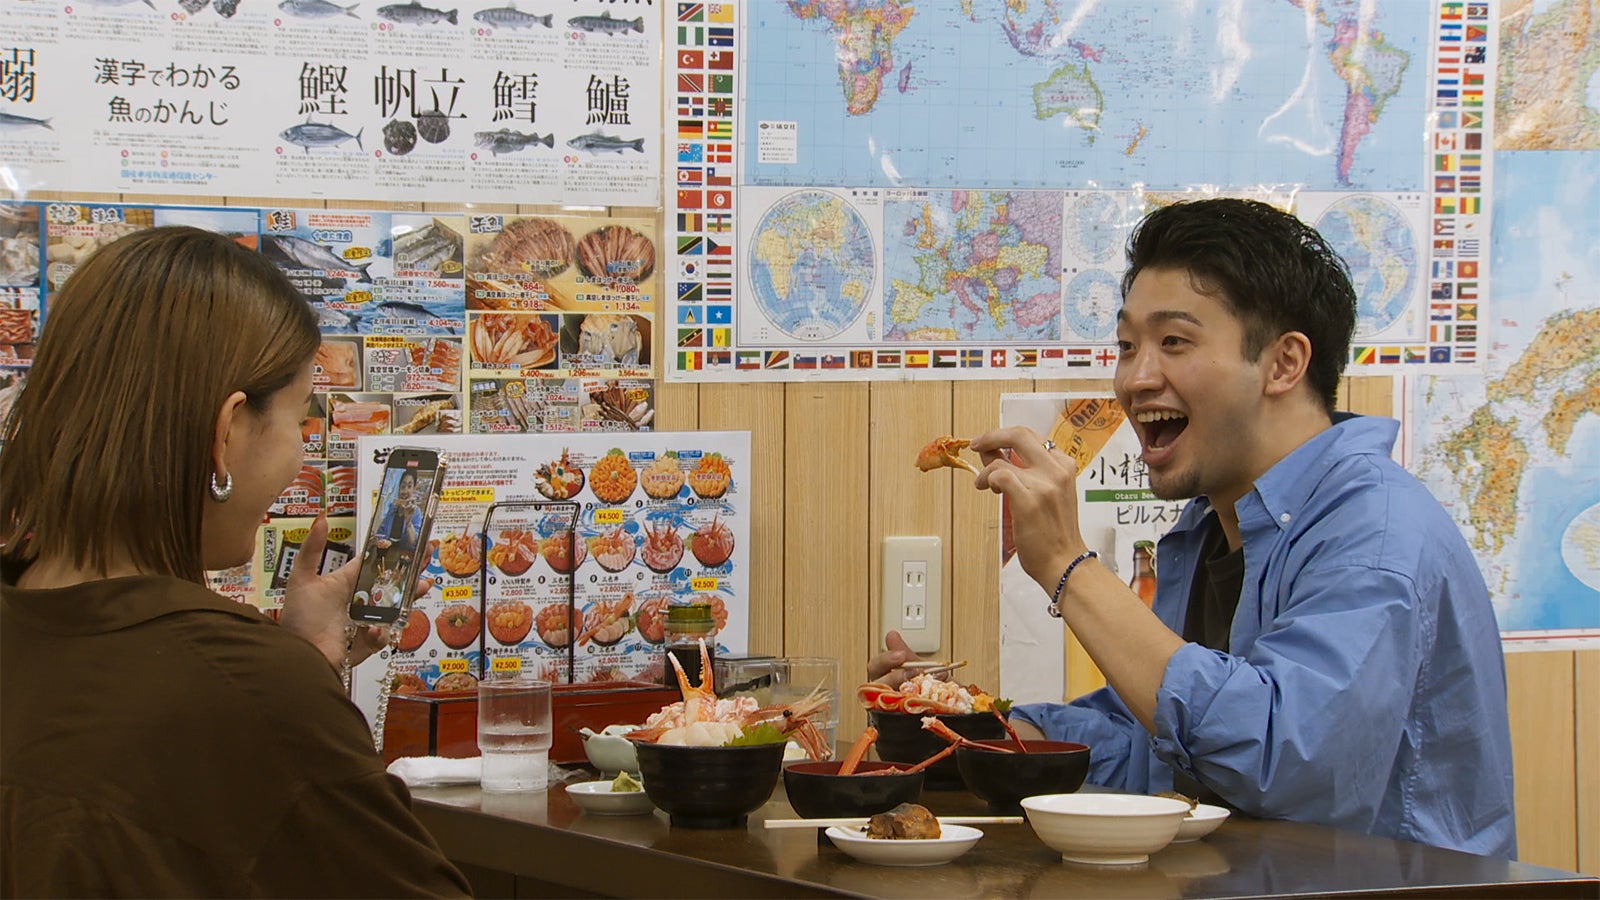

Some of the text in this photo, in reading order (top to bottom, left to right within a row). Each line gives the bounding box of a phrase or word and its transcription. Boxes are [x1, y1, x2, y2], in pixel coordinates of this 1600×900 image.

[94, 57, 240, 90] 漢字でわかる
[298, 61, 348, 116] 鰹
[374, 65, 467, 120] 帆立
[493, 70, 538, 123] 鱈
[586, 74, 631, 126] 鱸
[108, 95, 228, 126] 魚のかんじ
[1090, 453, 1150, 489] 小樽
[1115, 492, 1138, 500] Otaru
[598, 512, 620, 521] ¥4,500
[446, 589, 468, 597] ¥3,500
[693, 581, 714, 589] ¥2,500
[442, 663, 465, 672] ¥2,000
[495, 661, 518, 669] ¥2,500
